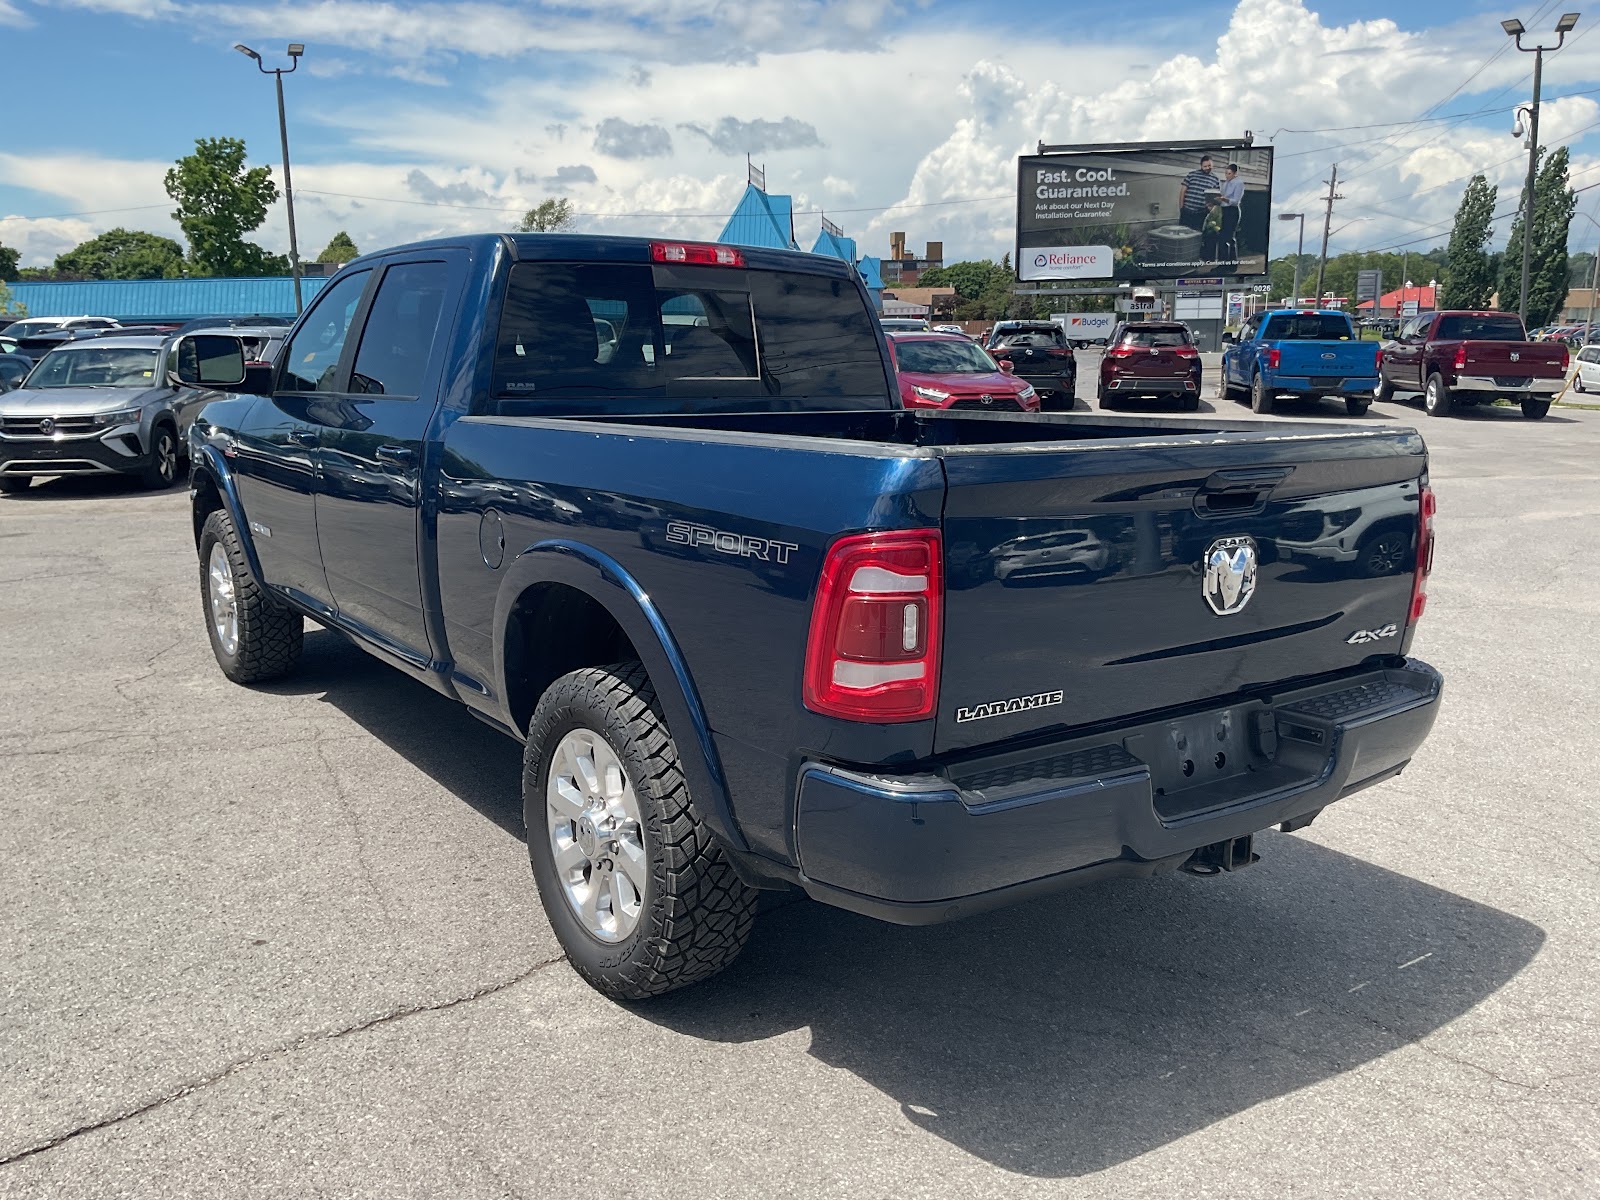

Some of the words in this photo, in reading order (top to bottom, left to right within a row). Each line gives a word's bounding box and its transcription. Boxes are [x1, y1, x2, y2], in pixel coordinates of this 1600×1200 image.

[1036, 170, 1071, 184] Fast.
[1075, 167, 1116, 182] Cool.
[1036, 183, 1131, 199] Guaranteed.
[1101, 201, 1115, 210] Day
[1049, 254, 1097, 265] Reliance
[1254, 284, 1271, 293] 0026
[1081, 318, 1109, 328] Budget
[666, 522, 799, 564] SPORT
[1217, 537, 1250, 548] RAM
[1345, 622, 1398, 645] 4x4
[956, 689, 1064, 723] LARAMIE
